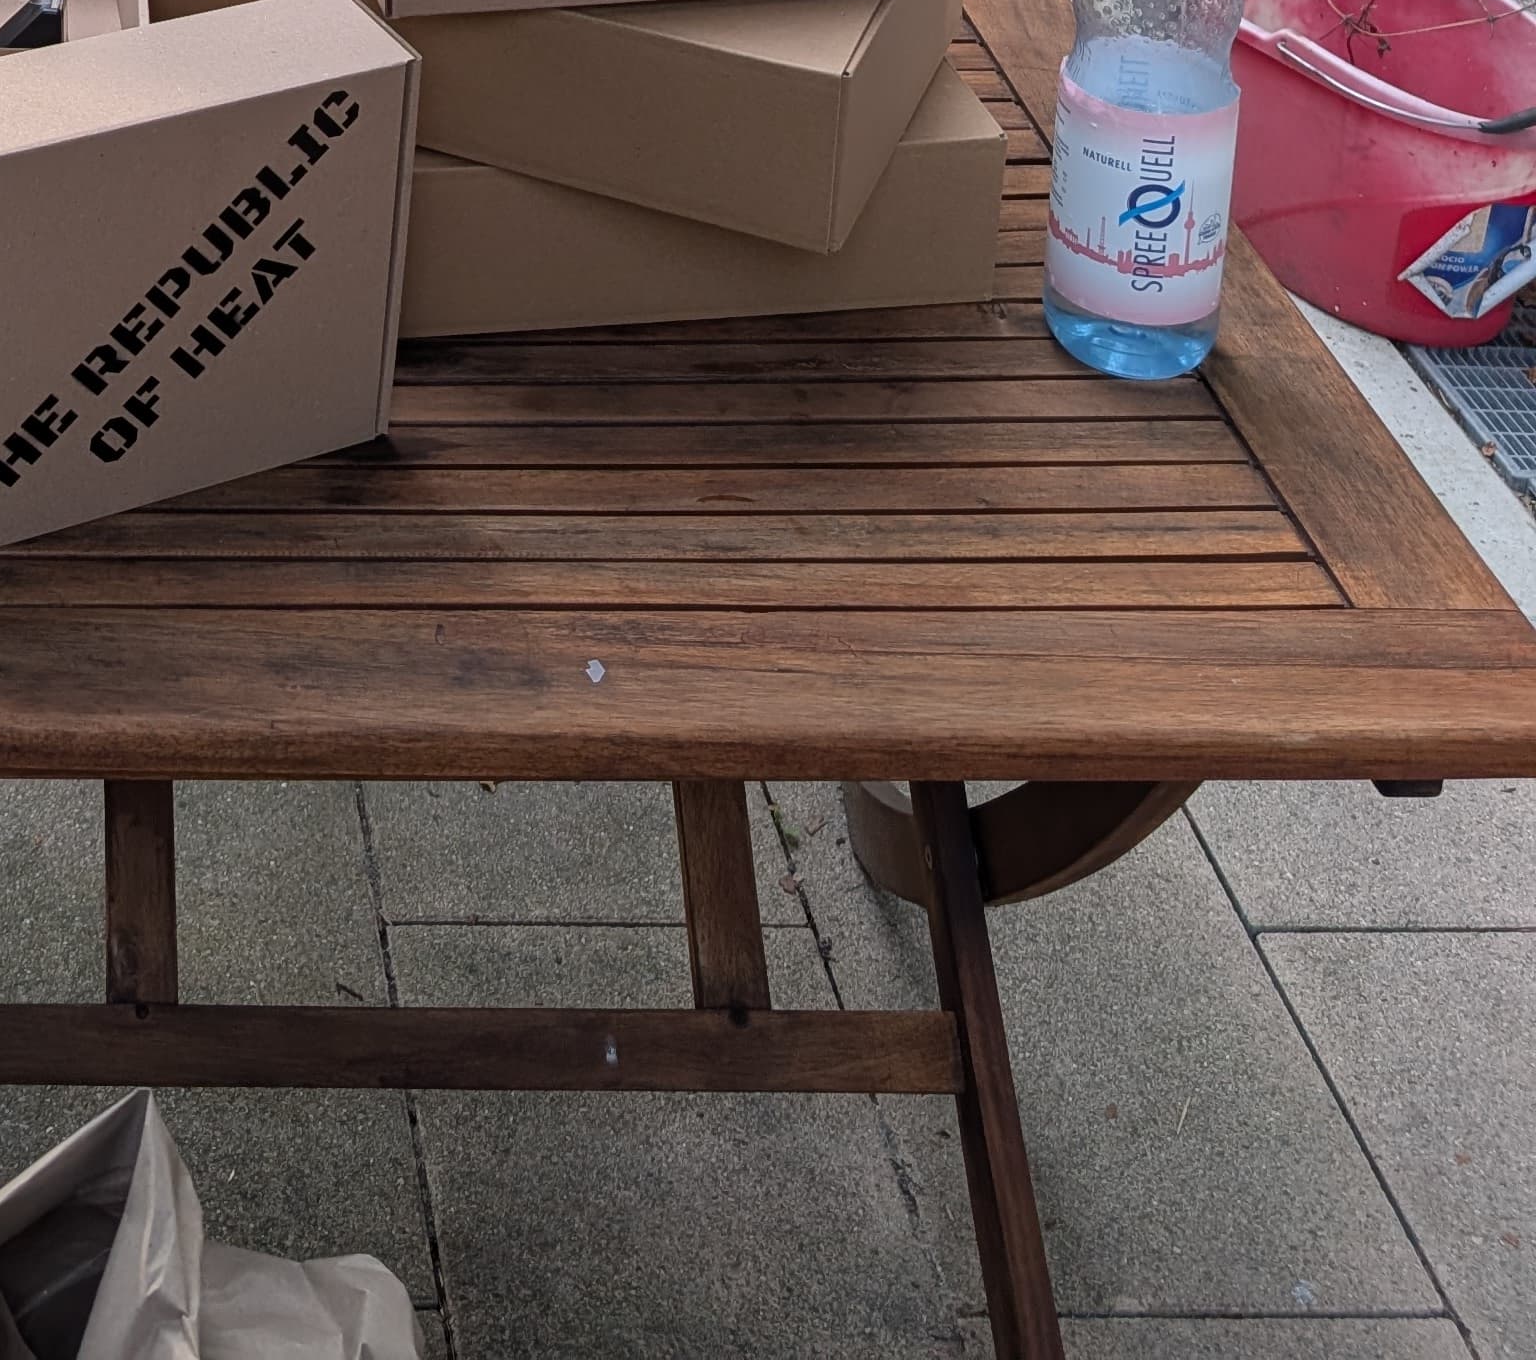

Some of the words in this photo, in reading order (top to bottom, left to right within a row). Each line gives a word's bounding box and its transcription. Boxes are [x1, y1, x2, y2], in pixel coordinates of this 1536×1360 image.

[1082, 146, 1133, 172] NATURELL
[70, 89, 360, 396] REPUBLIC
[1441, 255, 1465, 264] OCIO
[89, 375, 161, 463] OF
[169, 218, 317, 379] HEAT
